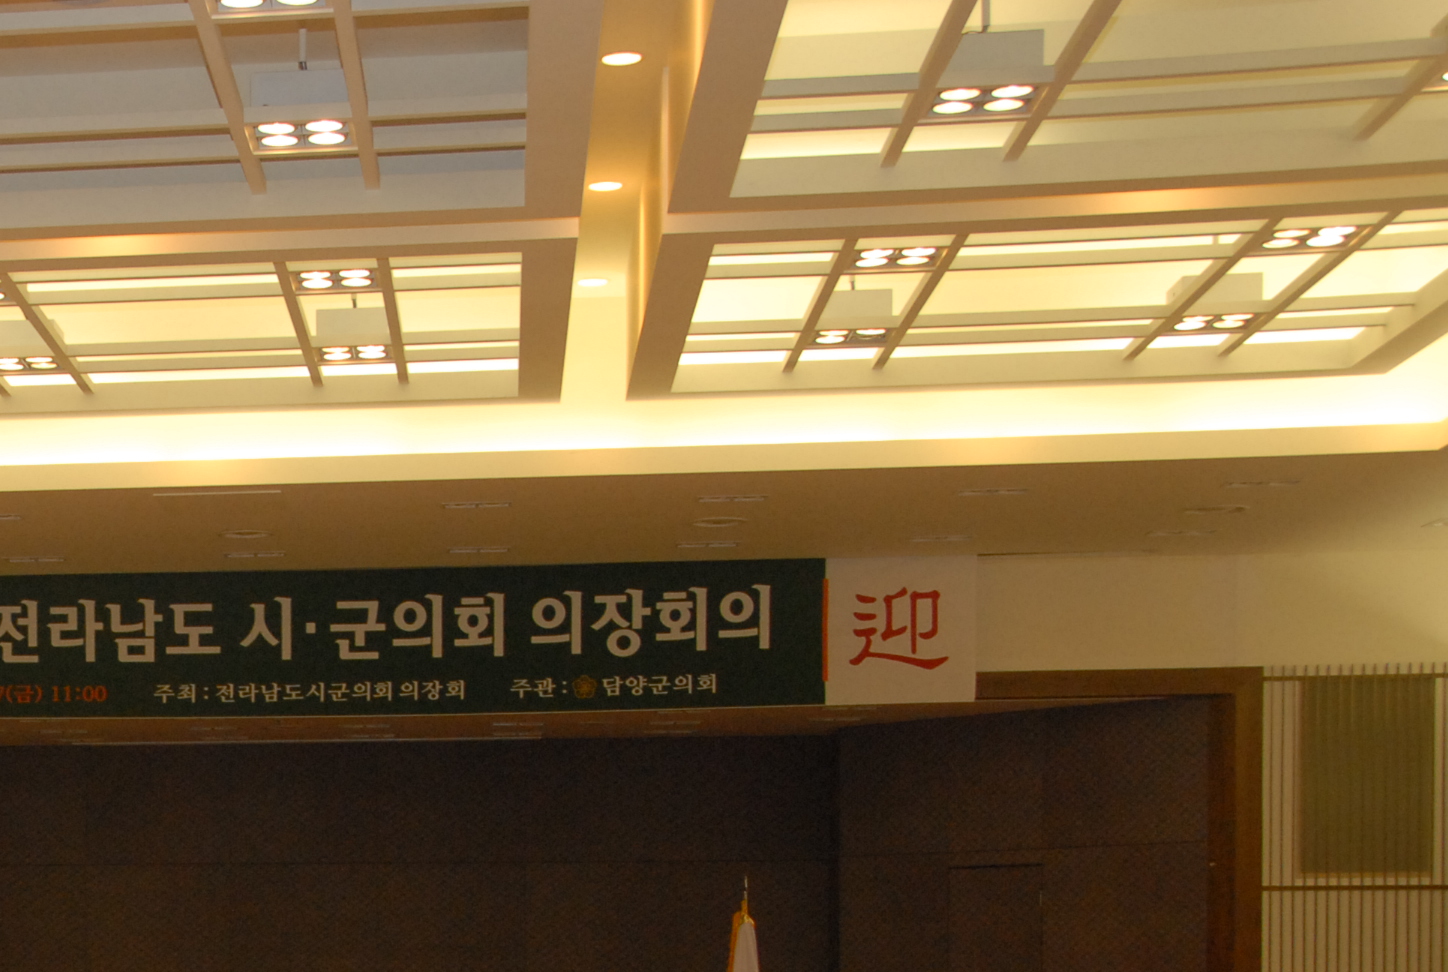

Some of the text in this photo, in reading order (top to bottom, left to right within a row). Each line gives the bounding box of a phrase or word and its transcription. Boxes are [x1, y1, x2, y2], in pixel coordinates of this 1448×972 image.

[530, 583, 772, 658] 의장회의
[849, 587, 950, 671] 迎
[51, 685, 109, 703] 11:00
[399, 680, 467, 702] 의장회
[602, 674, 719, 697] 담양군의회
